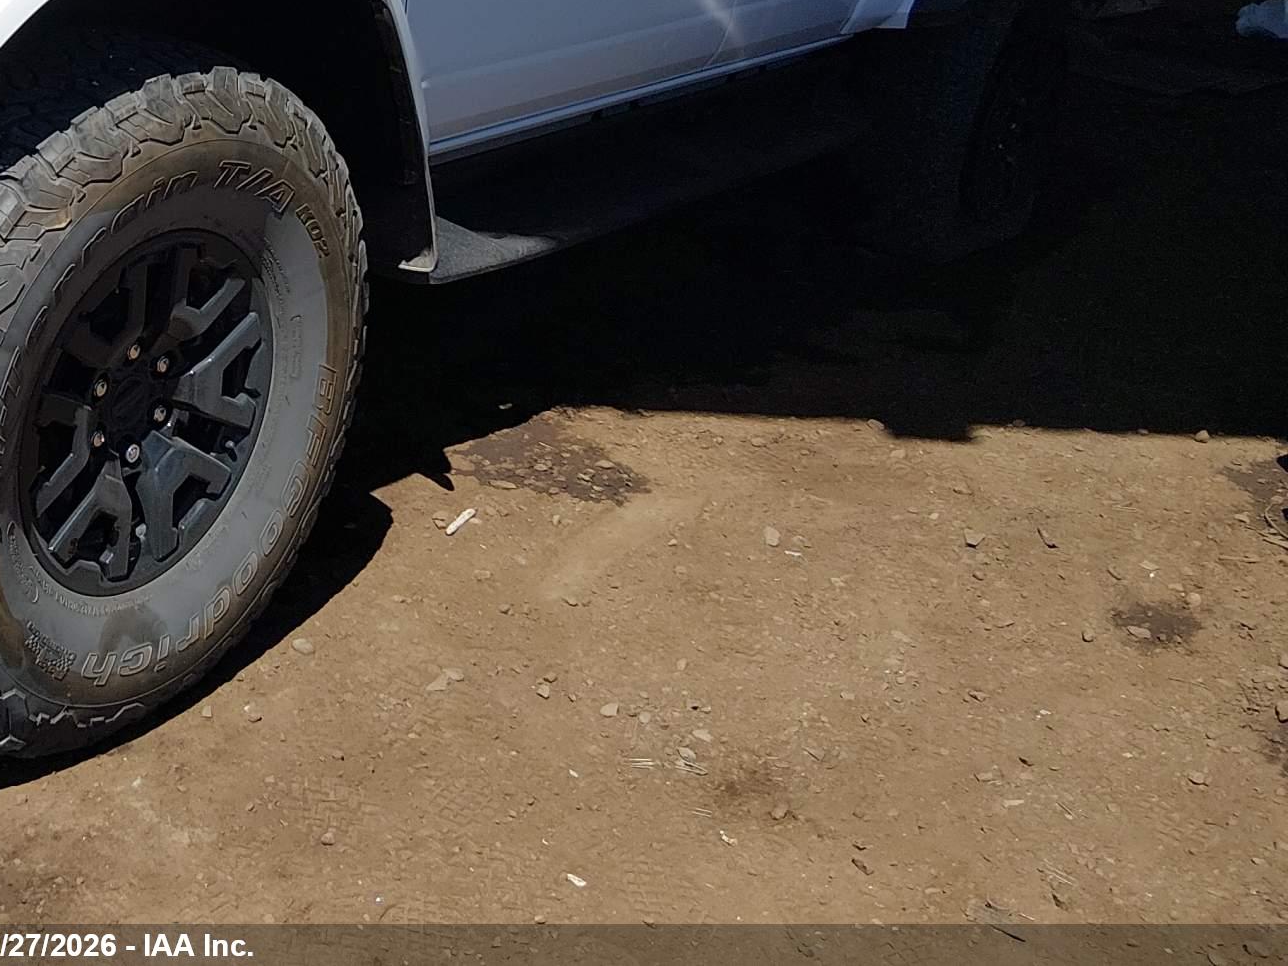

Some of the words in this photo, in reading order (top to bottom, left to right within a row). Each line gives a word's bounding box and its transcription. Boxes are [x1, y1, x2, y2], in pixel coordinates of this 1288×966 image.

[213, 160, 297, 216] T/A
[295, 204, 331, 259] KO2
[82, 363, 337, 687] BFGoodrich
